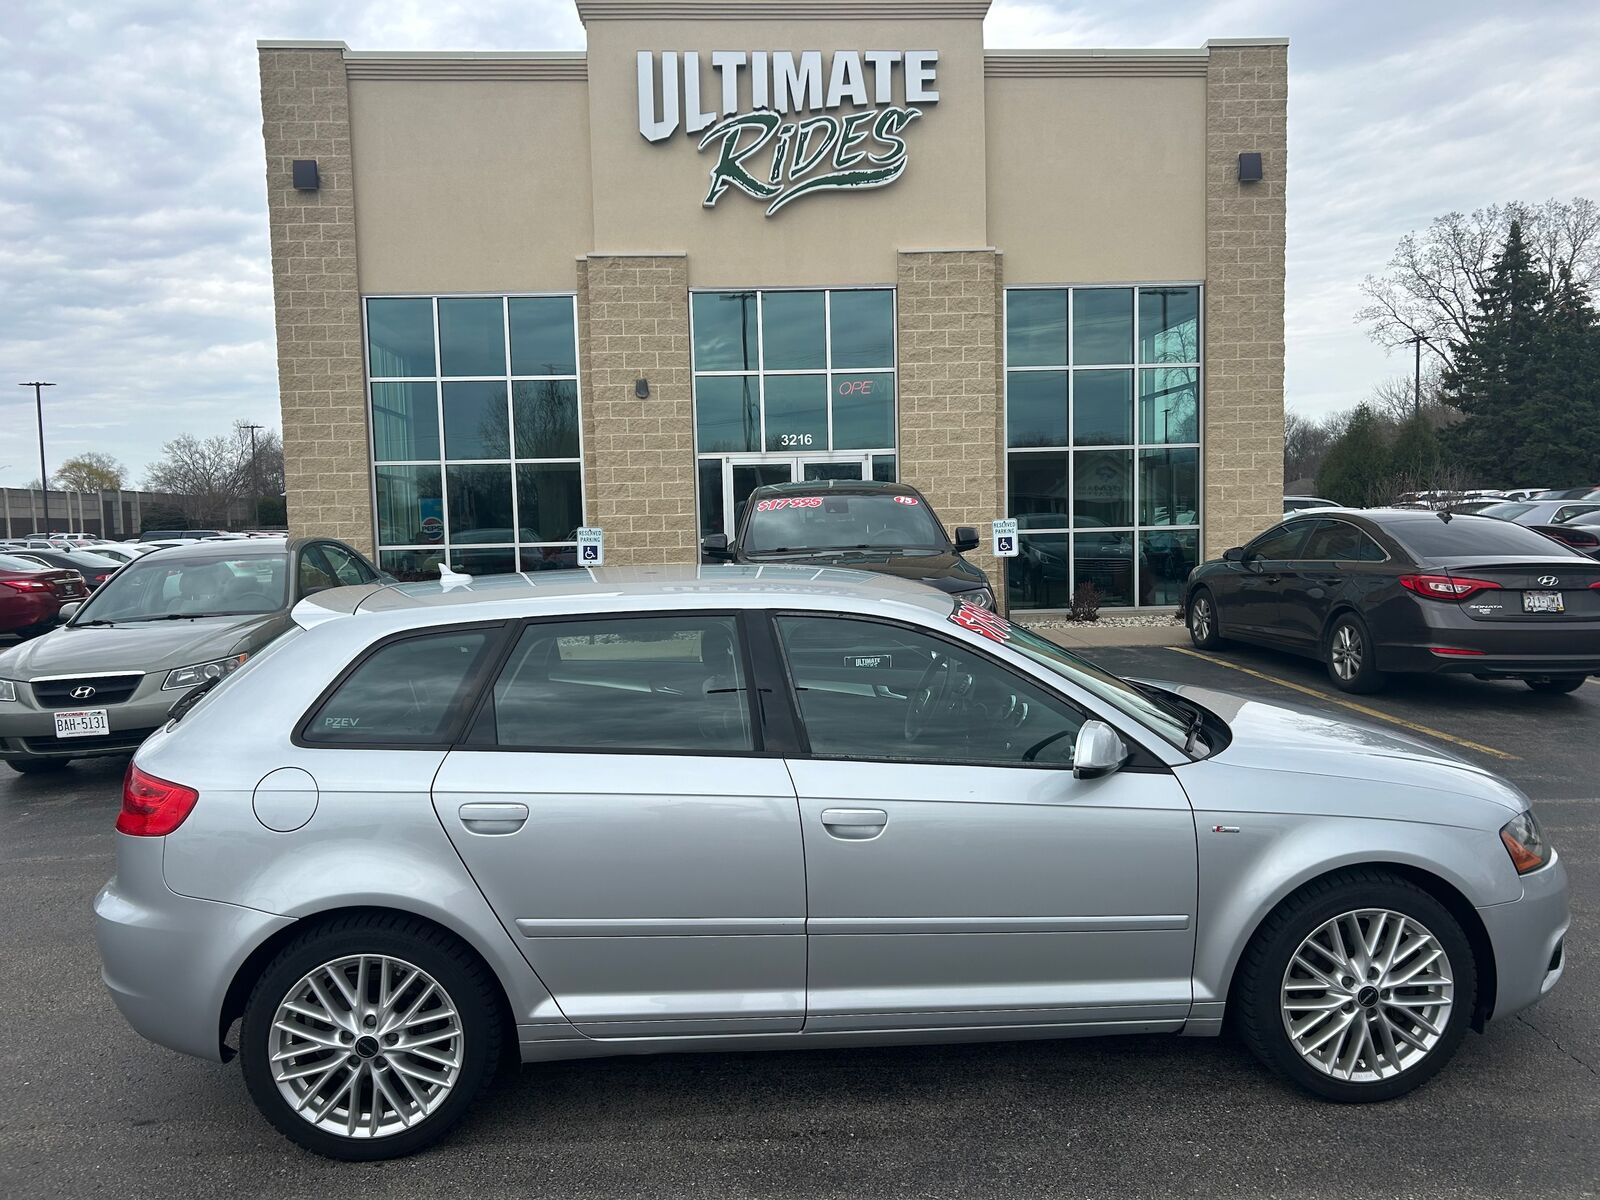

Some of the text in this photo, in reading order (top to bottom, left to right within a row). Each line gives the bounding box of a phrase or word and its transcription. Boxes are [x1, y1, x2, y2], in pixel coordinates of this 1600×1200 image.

[636, 50, 940, 143] ULTIMATE
[781, 433, 813, 446] 3216
[56, 716, 106, 731] BAH-5131
[324, 717, 360, 727] PZEV
